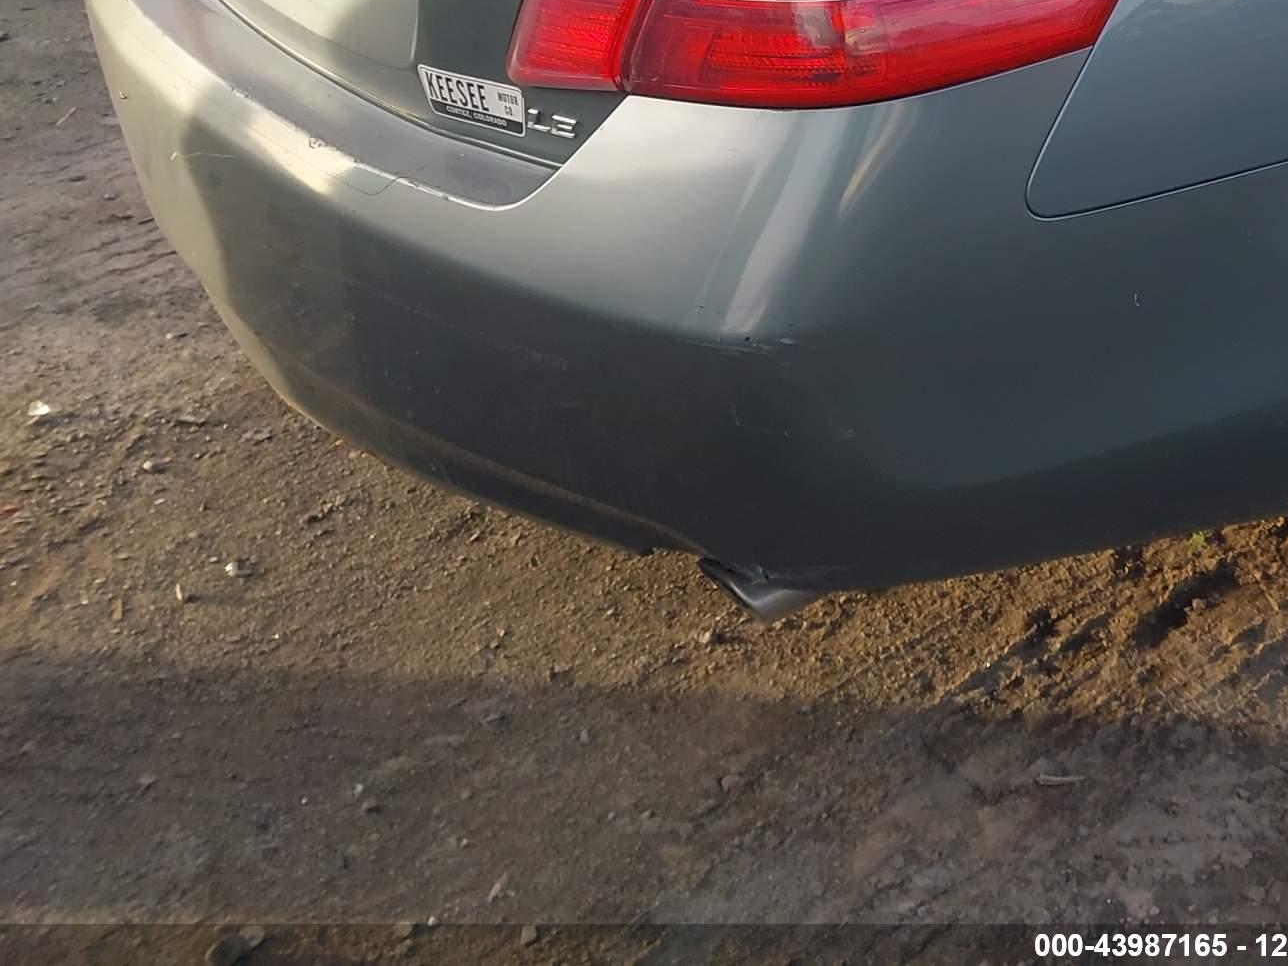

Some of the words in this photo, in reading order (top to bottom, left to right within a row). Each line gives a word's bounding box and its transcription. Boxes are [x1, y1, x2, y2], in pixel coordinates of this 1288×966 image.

[424, 71, 490, 112] KEESEE
[497, 91, 519, 106] MOTOR
[473, 112, 507, 127] COLORADO
[527, 108, 578, 139] LE
